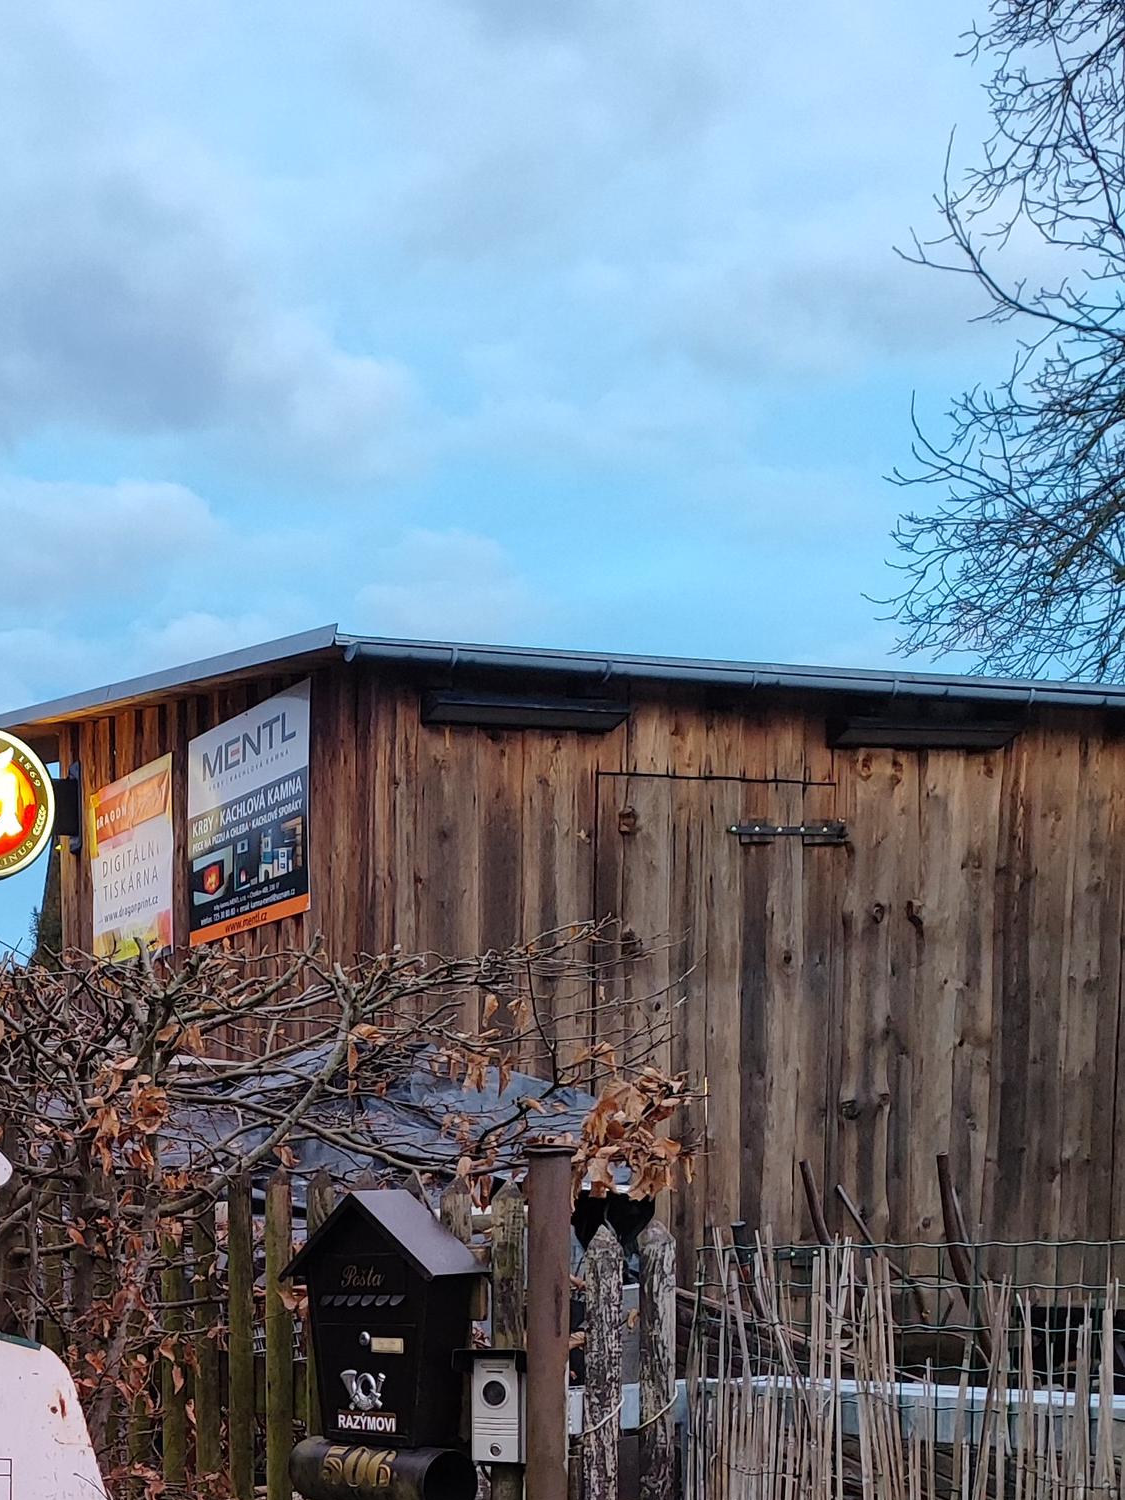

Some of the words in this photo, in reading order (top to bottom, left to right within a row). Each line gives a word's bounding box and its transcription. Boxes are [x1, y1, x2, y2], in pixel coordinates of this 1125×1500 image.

[203, 712, 296, 782] MENTL
[18, 755, 41, 787] 1869
[192, 815, 214, 838] KRBY
[220, 788, 265, 827] KACHLOVÁ
[267, 775, 303, 806] KAMNA
[103, 865, 159, 902] TISKÁRNA
[104, 896, 159, 922] www.dragonprint.cz
[225, 911, 268, 933] www.mentl.cz
[338, 1412, 396, 1433] RAZÝMOVI
